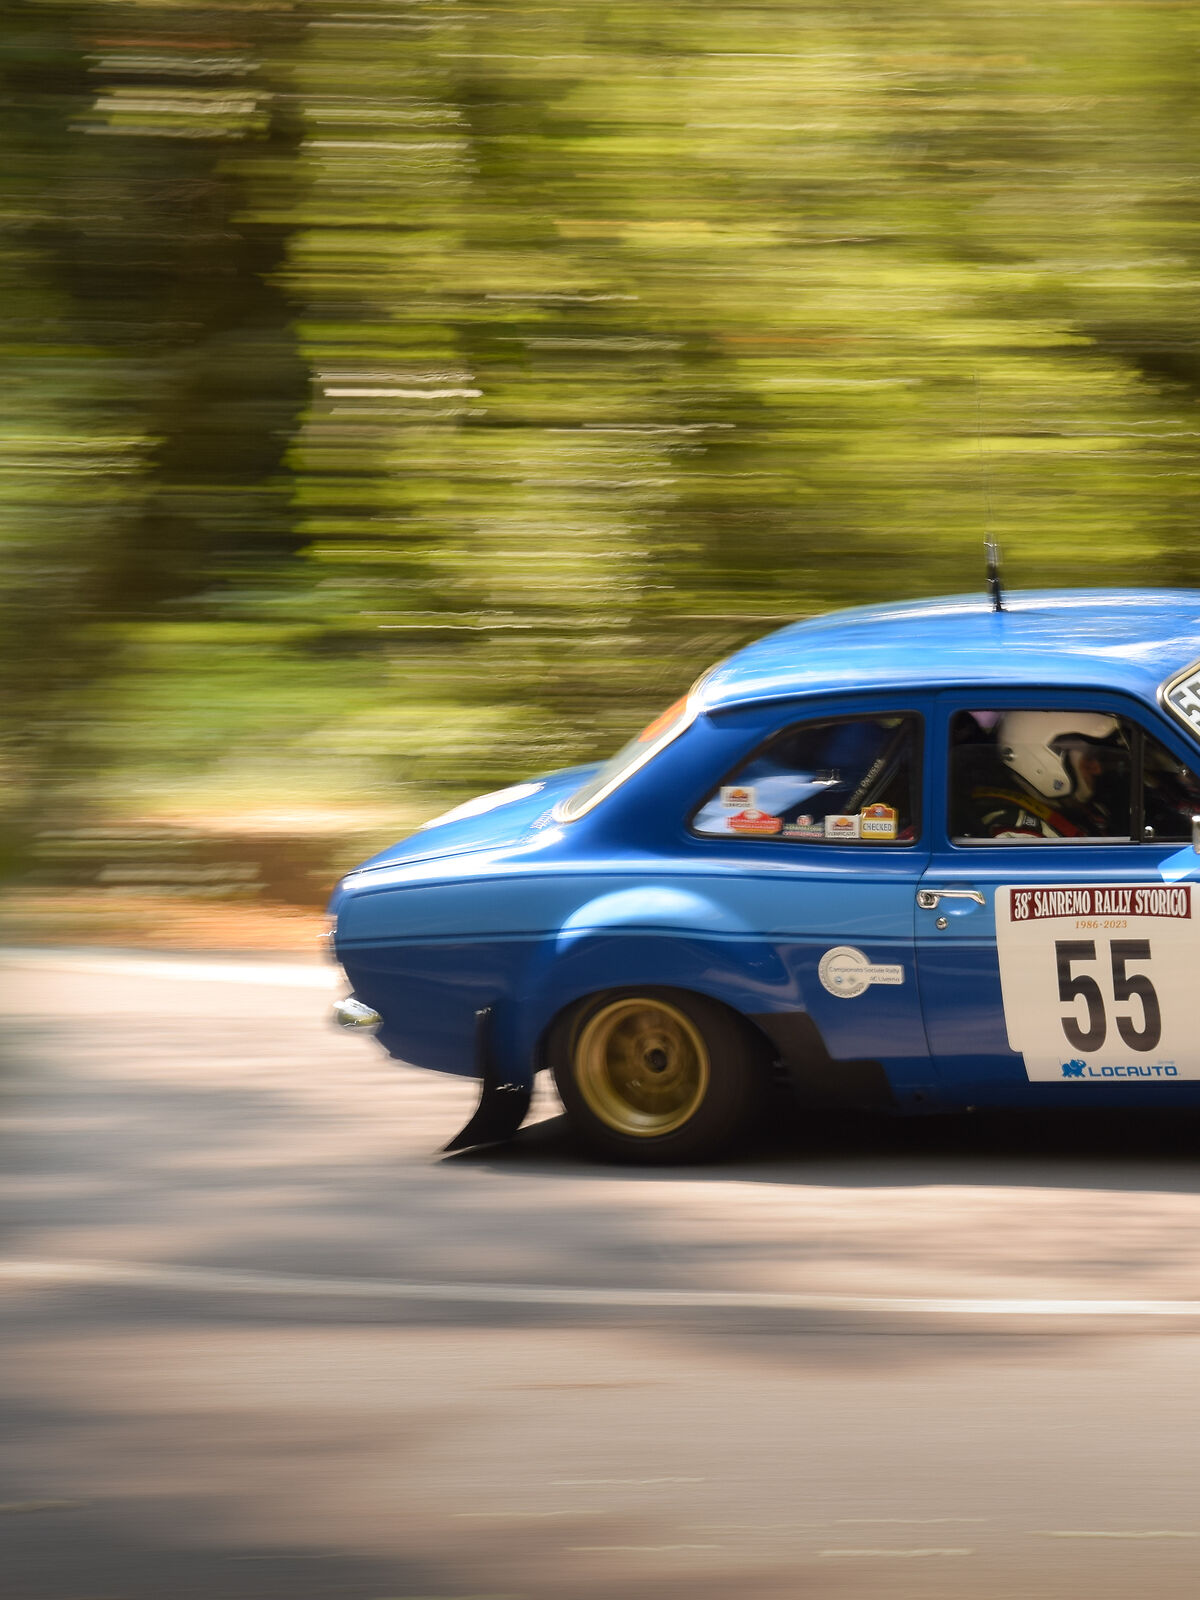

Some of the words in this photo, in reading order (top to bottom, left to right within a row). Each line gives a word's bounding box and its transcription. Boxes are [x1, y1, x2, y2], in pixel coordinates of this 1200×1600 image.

[863, 823, 892, 831] CHECKED
[1034, 890, 1091, 916] SANREMO
[1094, 890, 1134, 914] RALLY
[1135, 888, 1187, 916] STORICO
[1055, 939, 1162, 1052] 55
[1088, 1066, 1178, 1077] LOCAUTO
